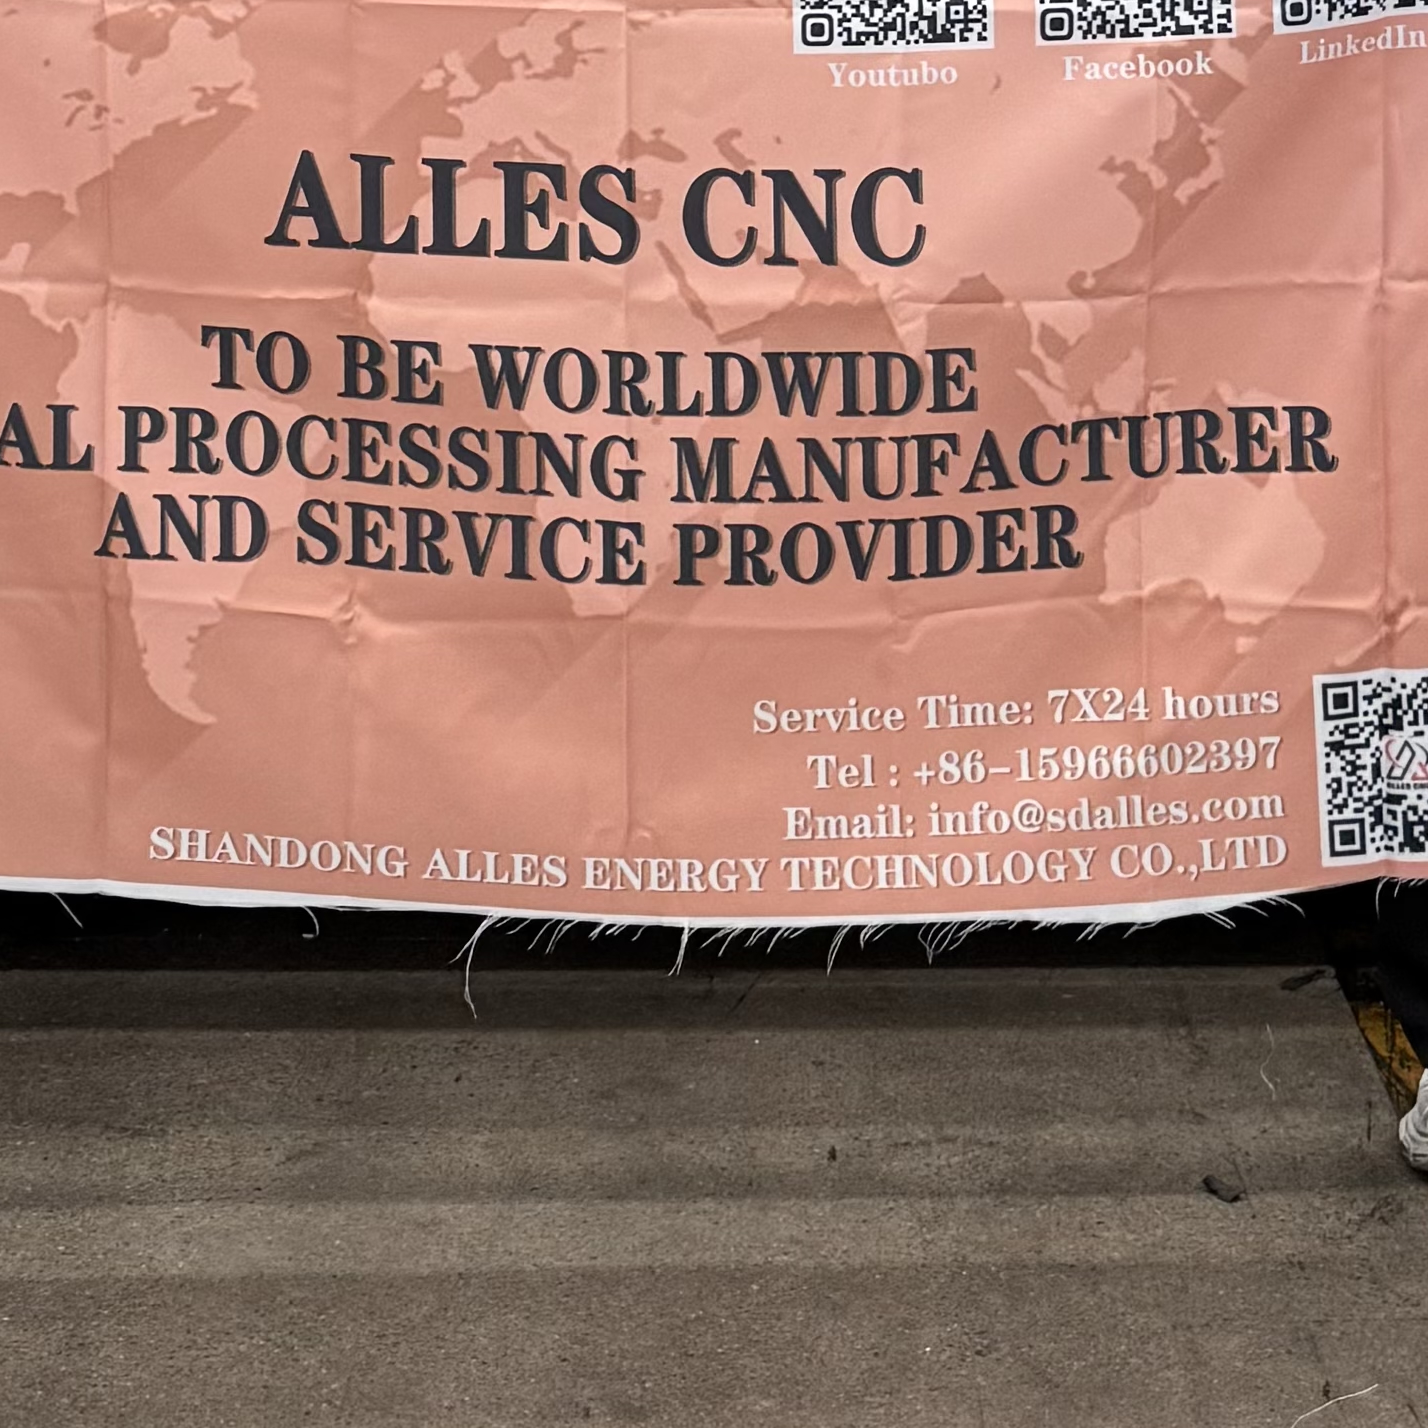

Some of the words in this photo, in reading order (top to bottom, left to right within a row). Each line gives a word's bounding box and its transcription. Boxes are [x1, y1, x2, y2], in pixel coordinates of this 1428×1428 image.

[1062, 50, 1215, 82] Facebook
[1299, 24, 1428, 65] LinkedIn
[264, 149, 641, 265] ALLES
[682, 166, 927, 268] CNC
[201, 324, 312, 394] TO
[337, 333, 444, 406] BE
[469, 343, 978, 419] WORLDWIDE
[117, 404, 647, 504] PROCESSING
[670, 404, 1339, 505] MANUFACTURER
[94, 491, 271, 564] AND
[296, 498, 647, 587] SERVICE
[673, 502, 1084, 587] PROVIDER
[752, 696, 906, 735] Service
[917, 694, 1034, 730] Time:
[1047, 686, 1150, 725] 7X24
[1161, 685, 1280, 721] hours
[806, 753, 877, 790] Tel
[913, 735, 1282, 786] +86-15966602397
[782, 803, 916, 841] Email:
[927, 793, 1285, 837] info@sdalles.com
[149, 825, 410, 878] SHANDONG
[422, 847, 569, 888] ALLES
[581, 857, 770, 893] ENERGY
[780, 844, 1097, 893] TECHNOLOGY
[1109, 834, 1290, 882] CO.,LTD
